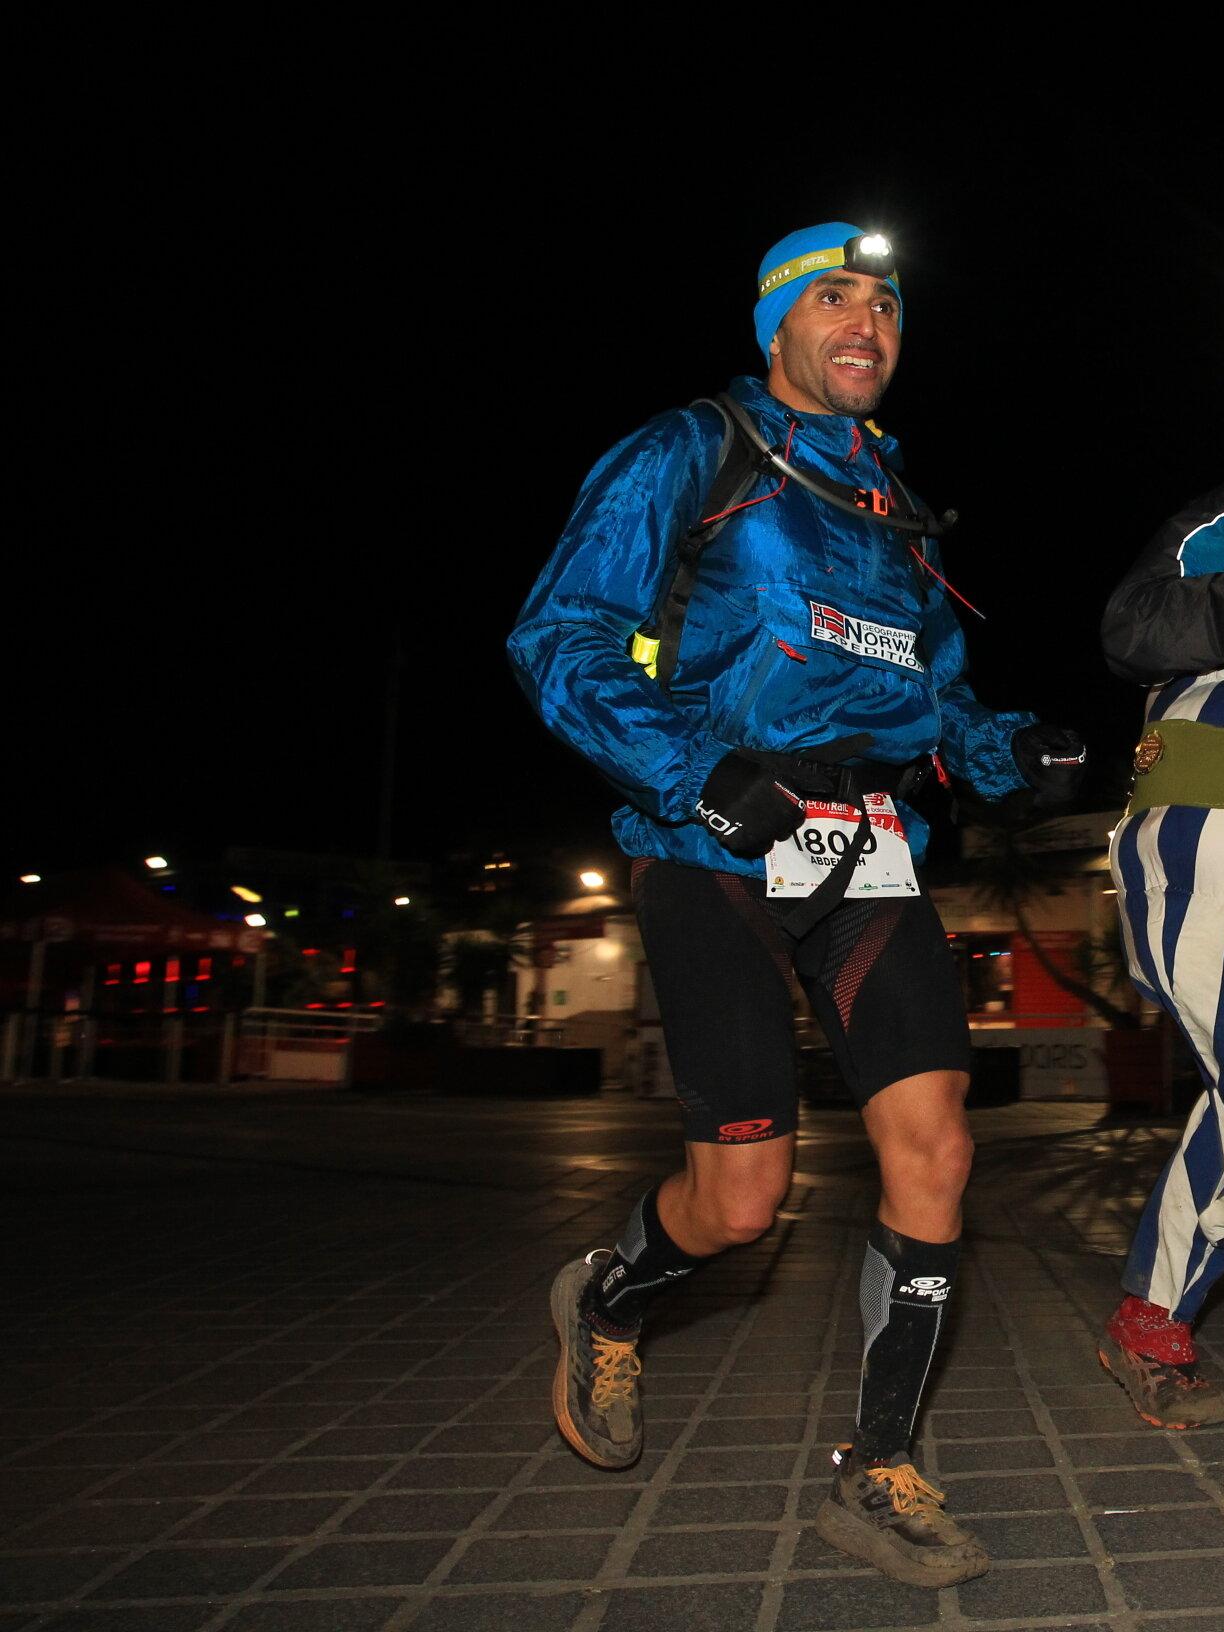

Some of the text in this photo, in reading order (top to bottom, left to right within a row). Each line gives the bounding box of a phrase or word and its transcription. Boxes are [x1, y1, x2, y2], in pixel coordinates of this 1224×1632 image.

[735, 1130, 775, 1142] SPORT
[899, 1285, 952, 1297] BV SPORT
